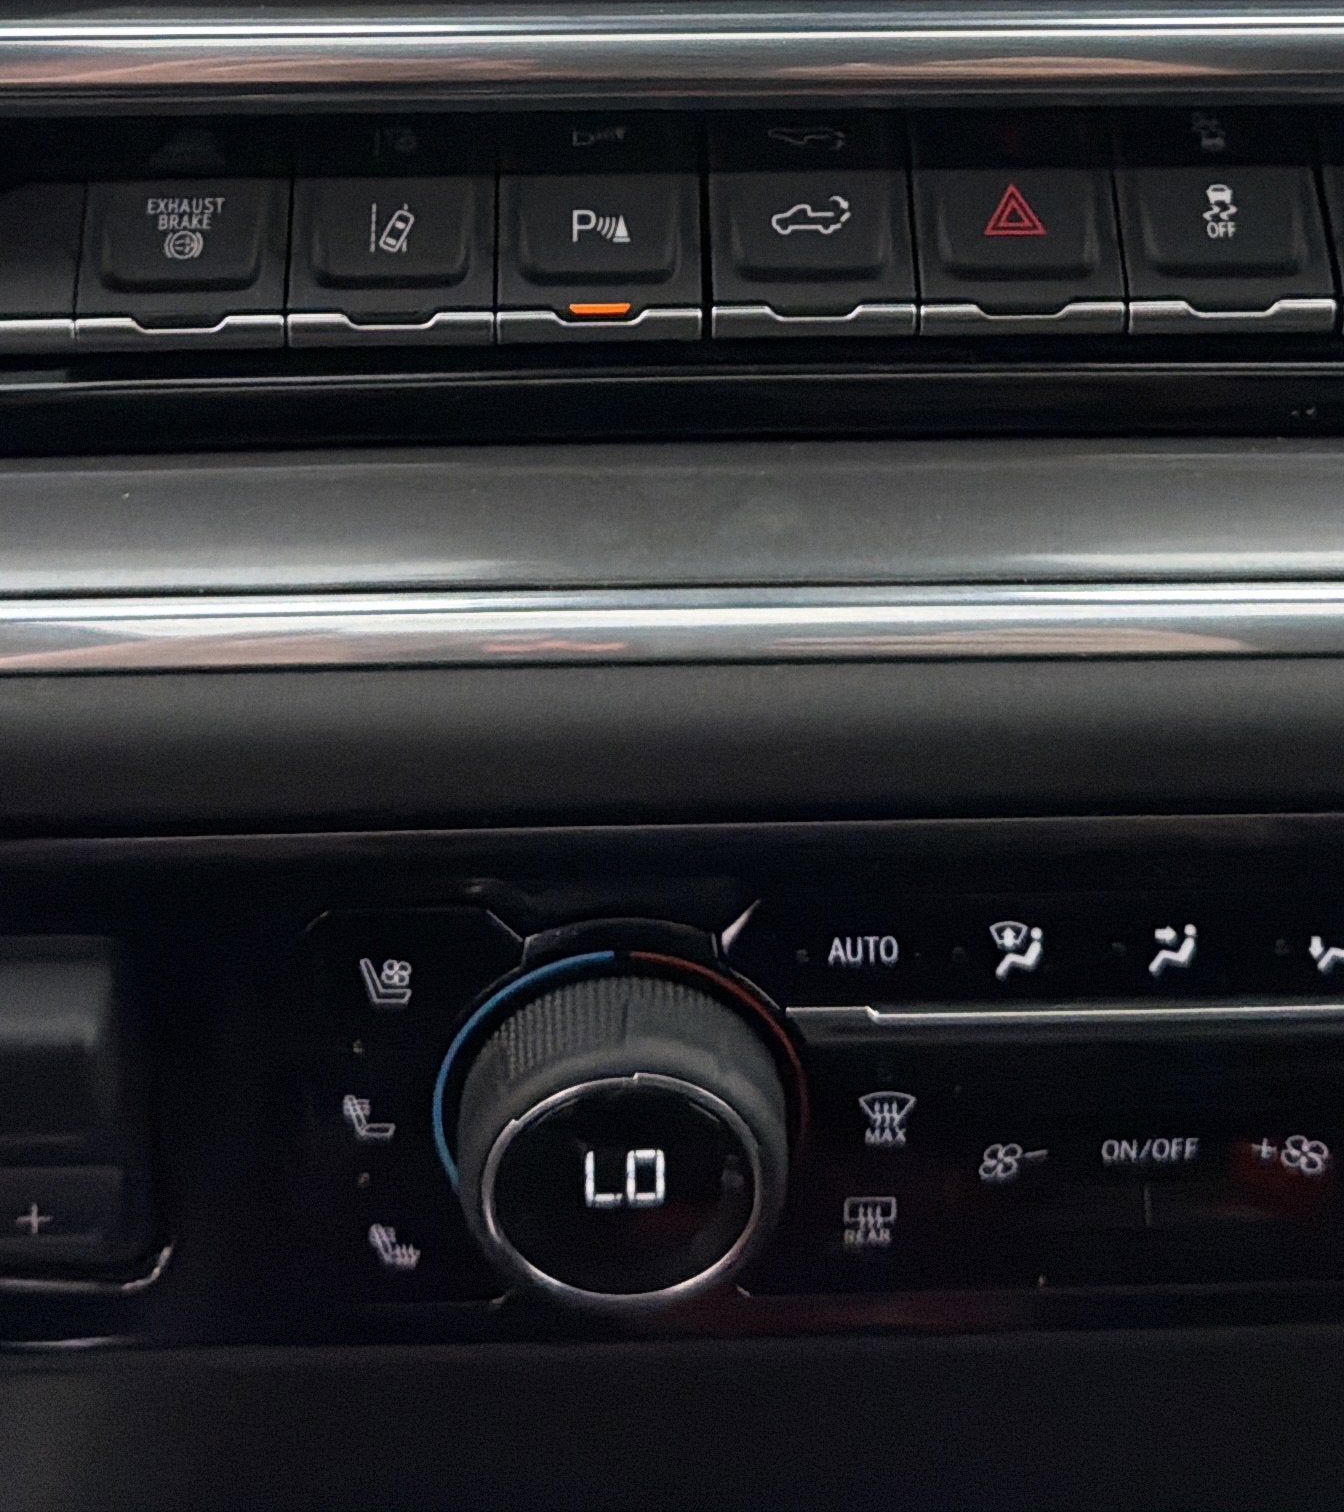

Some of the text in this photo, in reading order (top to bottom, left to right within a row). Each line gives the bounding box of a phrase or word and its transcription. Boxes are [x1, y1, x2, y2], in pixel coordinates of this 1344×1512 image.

[146, 197, 226, 214] EXHAUST
[157, 212, 212, 230] BRAKE
[1206, 221, 1236, 239] OFF
[827, 935, 899, 967] AUTO
[864, 1127, 907, 1144] MAX
[1100, 1137, 1200, 1162] ON/OFF
[584, 1148, 666, 1208] LO
[843, 1228, 892, 1245] REAR
